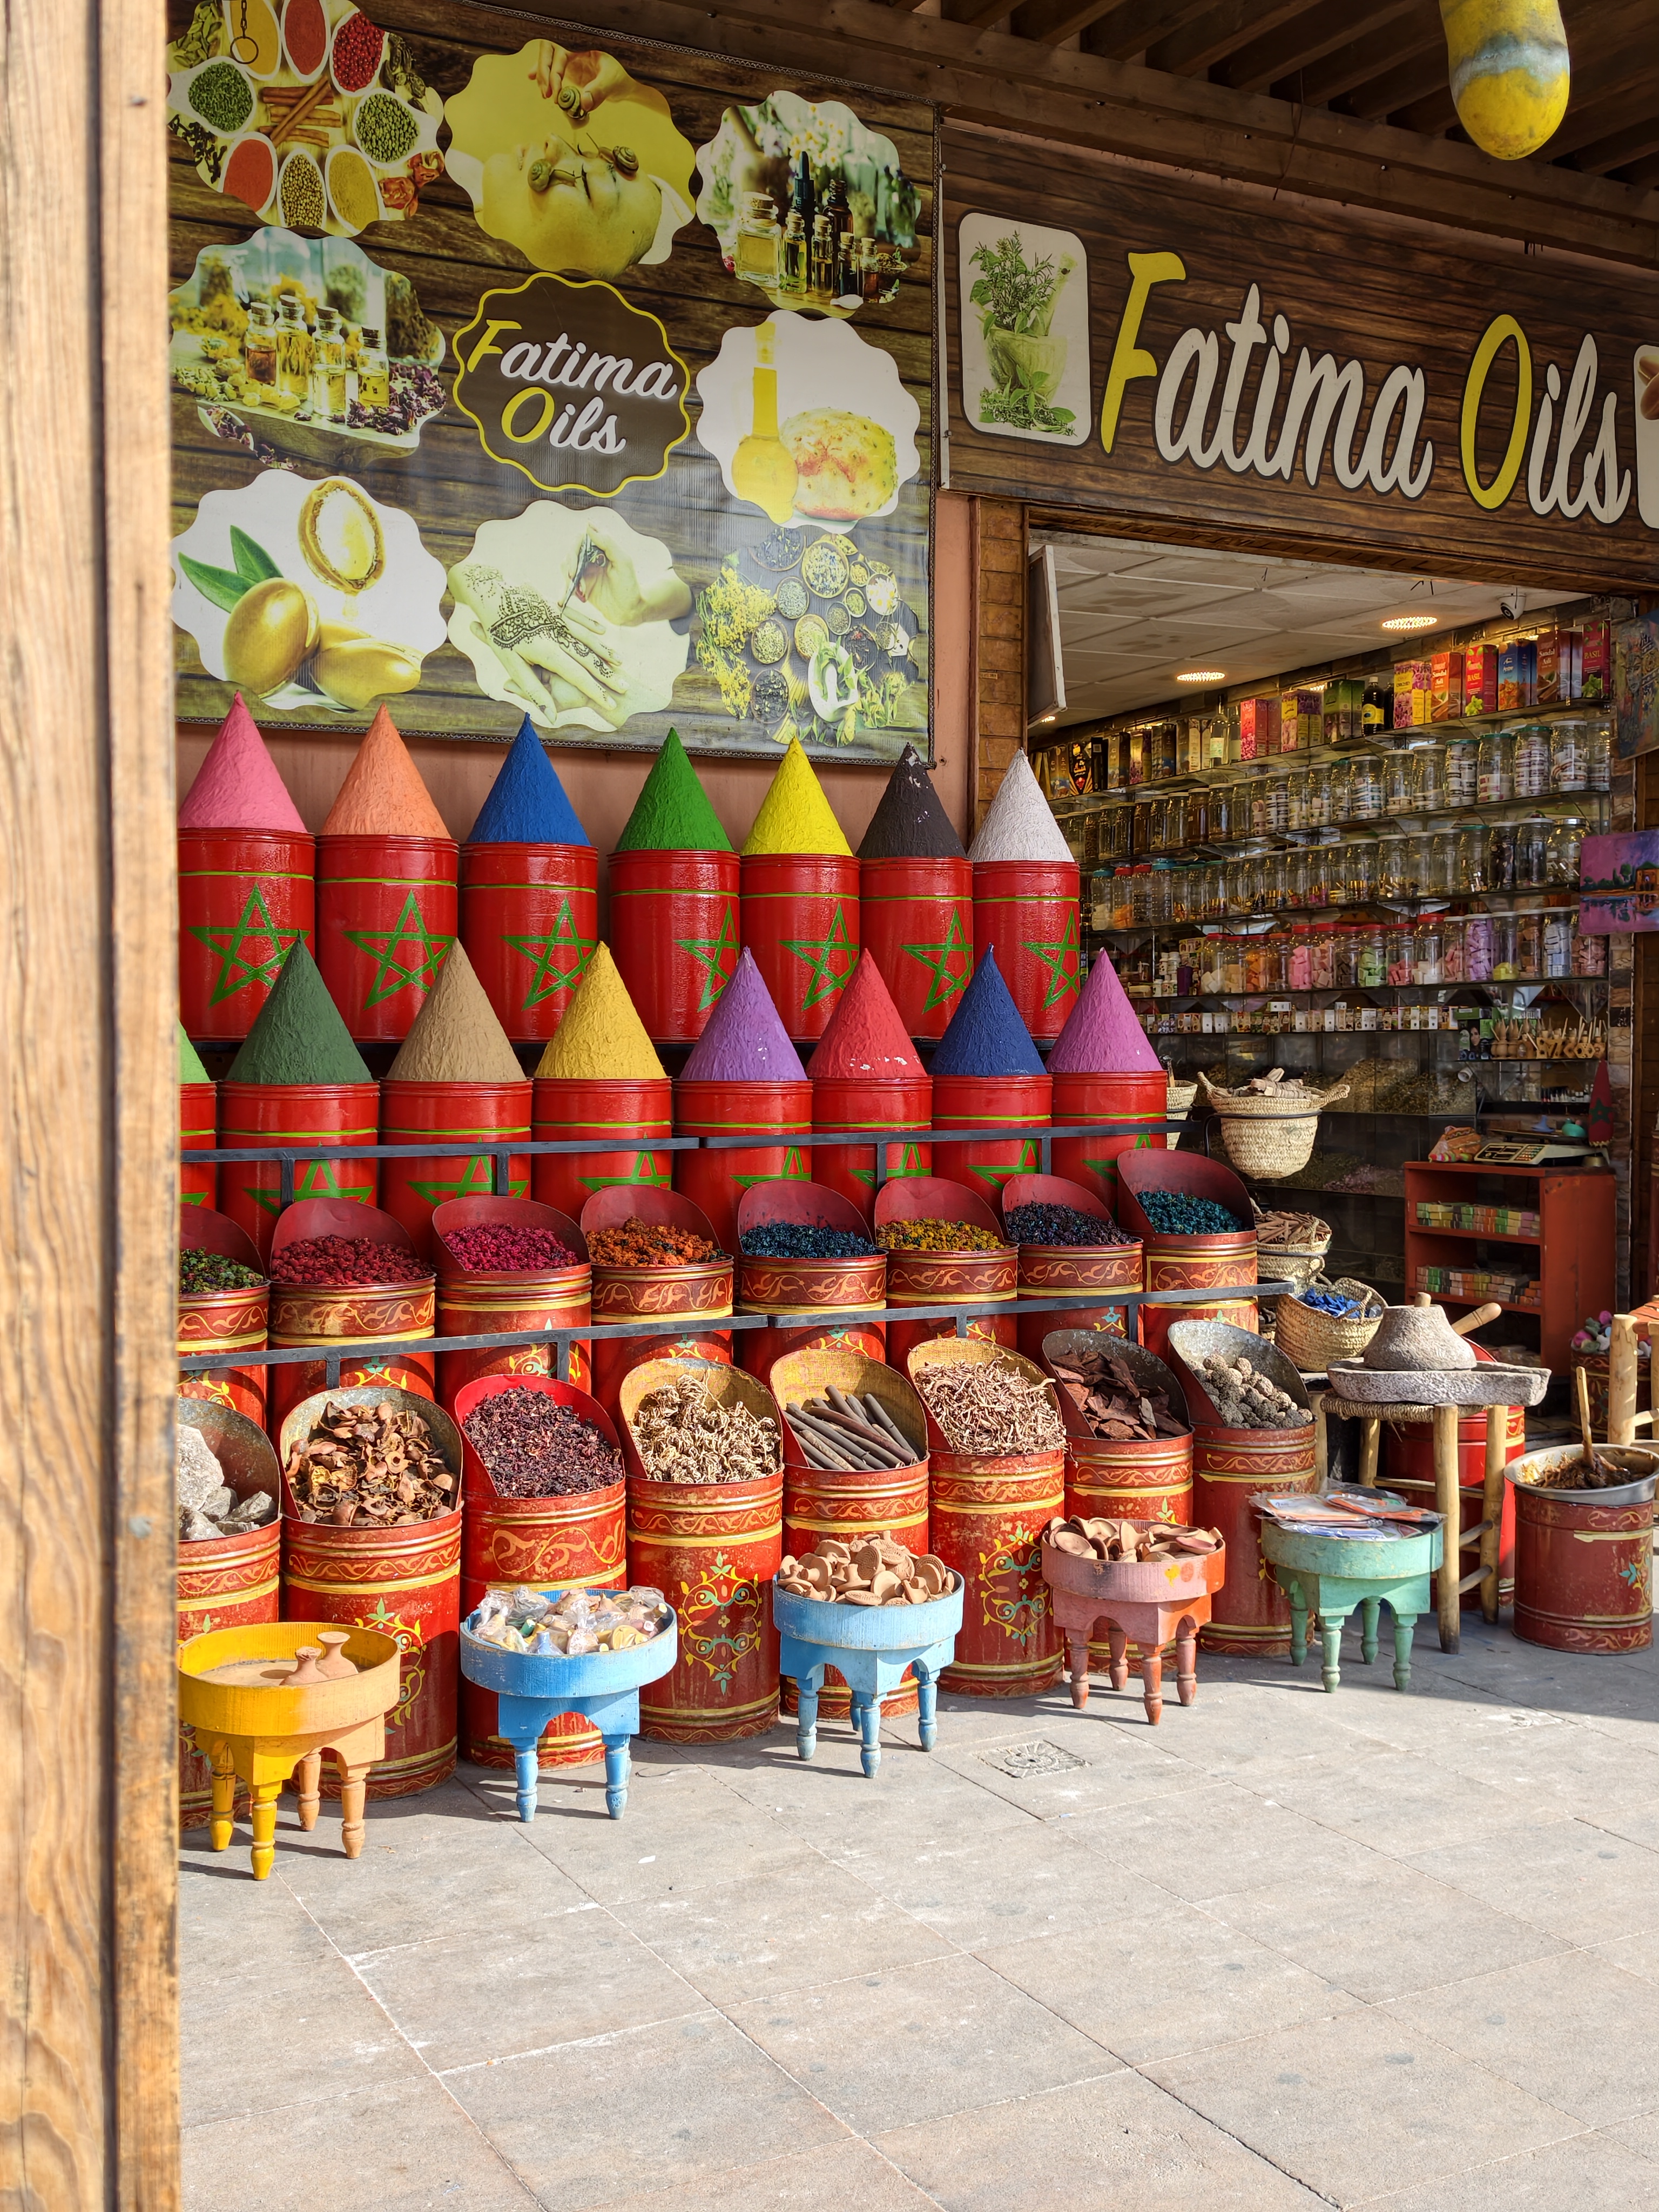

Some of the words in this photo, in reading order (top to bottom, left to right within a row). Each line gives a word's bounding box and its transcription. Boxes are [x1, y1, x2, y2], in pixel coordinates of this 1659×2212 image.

[467, 319, 678, 399] Fatima
[1101, 251, 1434, 498] Fatima
[1460, 313, 1631, 524] Oils
[501, 387, 626, 454] Oils
[1539, 649, 1555, 657] Sandal
[1584, 650, 1601, 659] BASIL
[1433, 670, 1446, 678] Sandal
